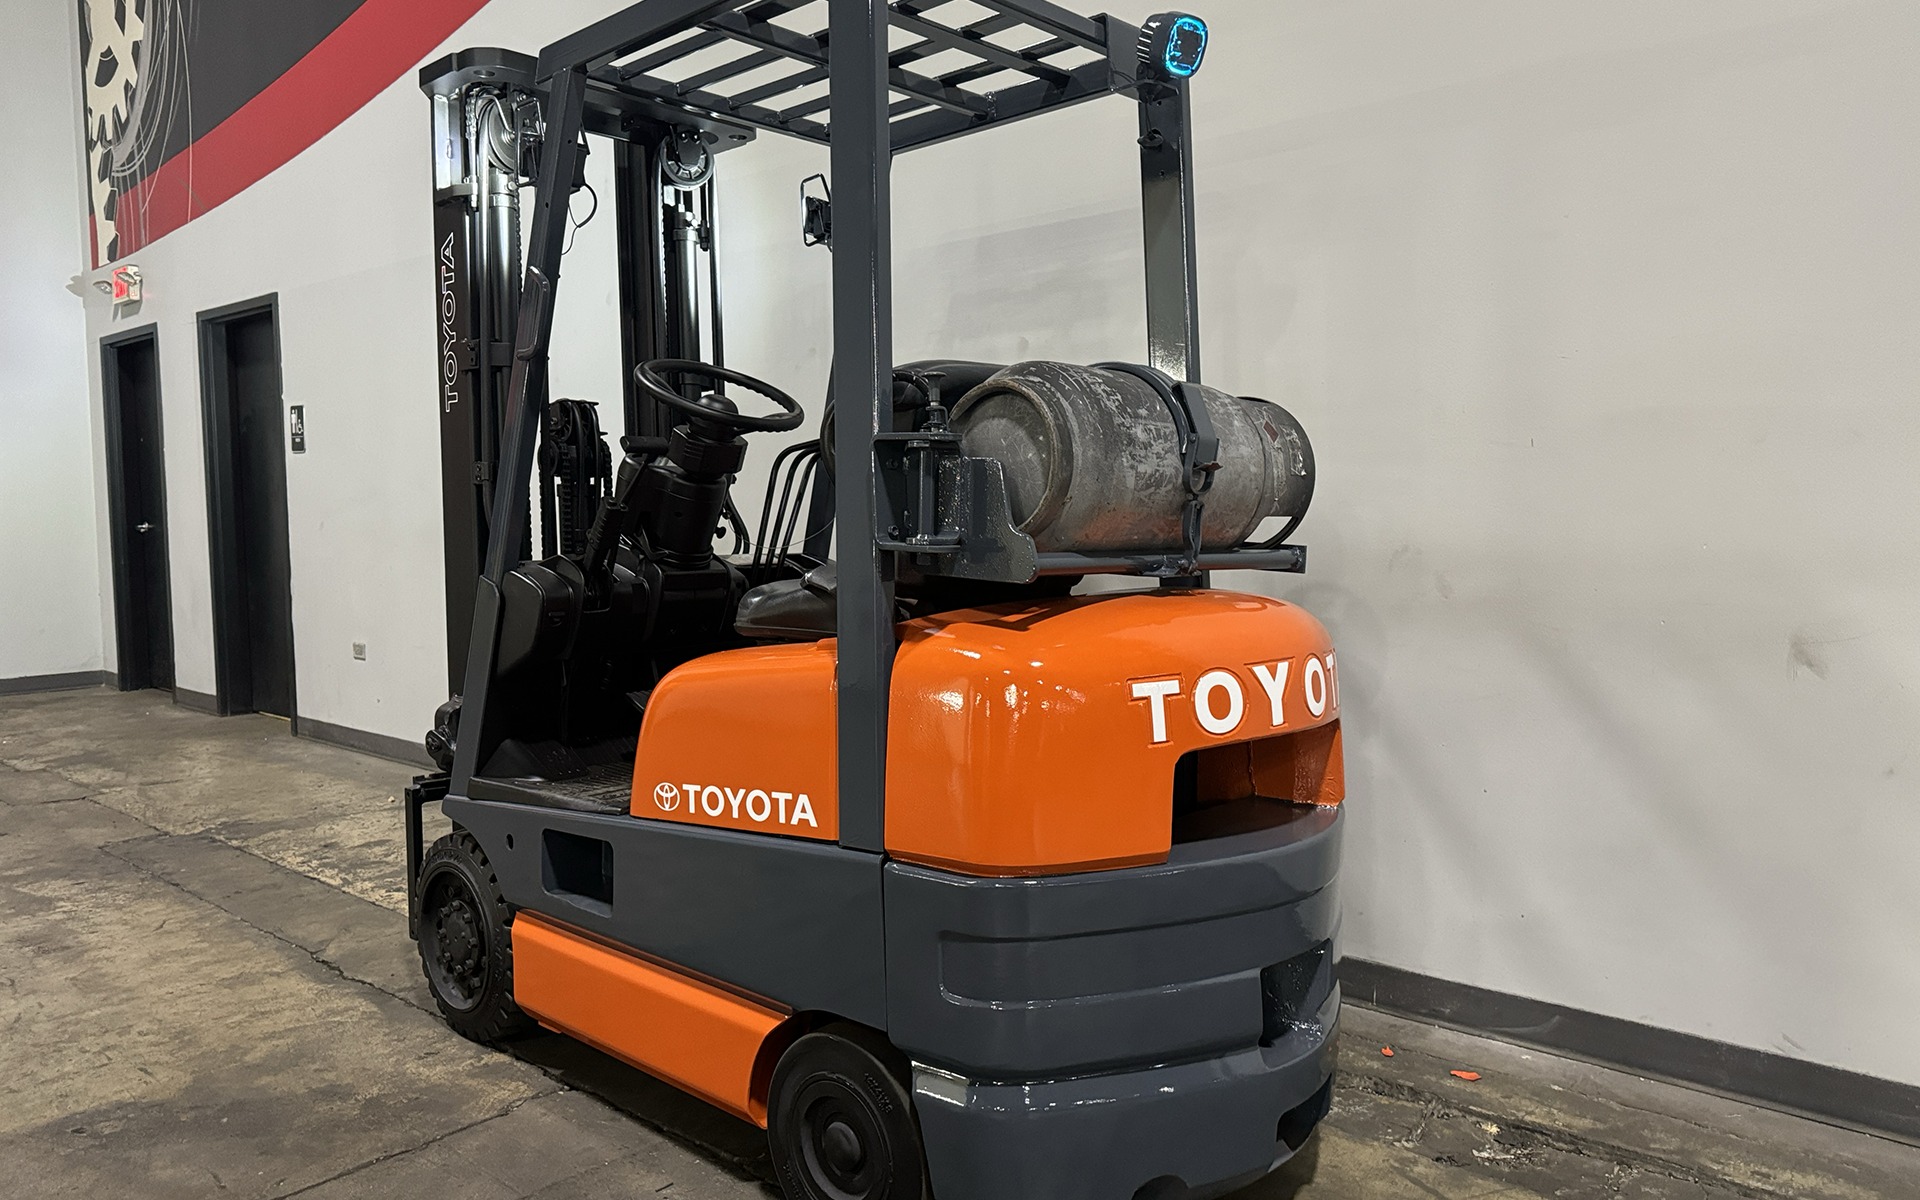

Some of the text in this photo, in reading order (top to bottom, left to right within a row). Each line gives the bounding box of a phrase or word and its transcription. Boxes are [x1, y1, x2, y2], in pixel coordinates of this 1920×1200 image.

[441, 232, 458, 412] TOYOTA
[1132, 654, 1339, 742] TOYOT
[682, 784, 818, 828] TOYOTA
